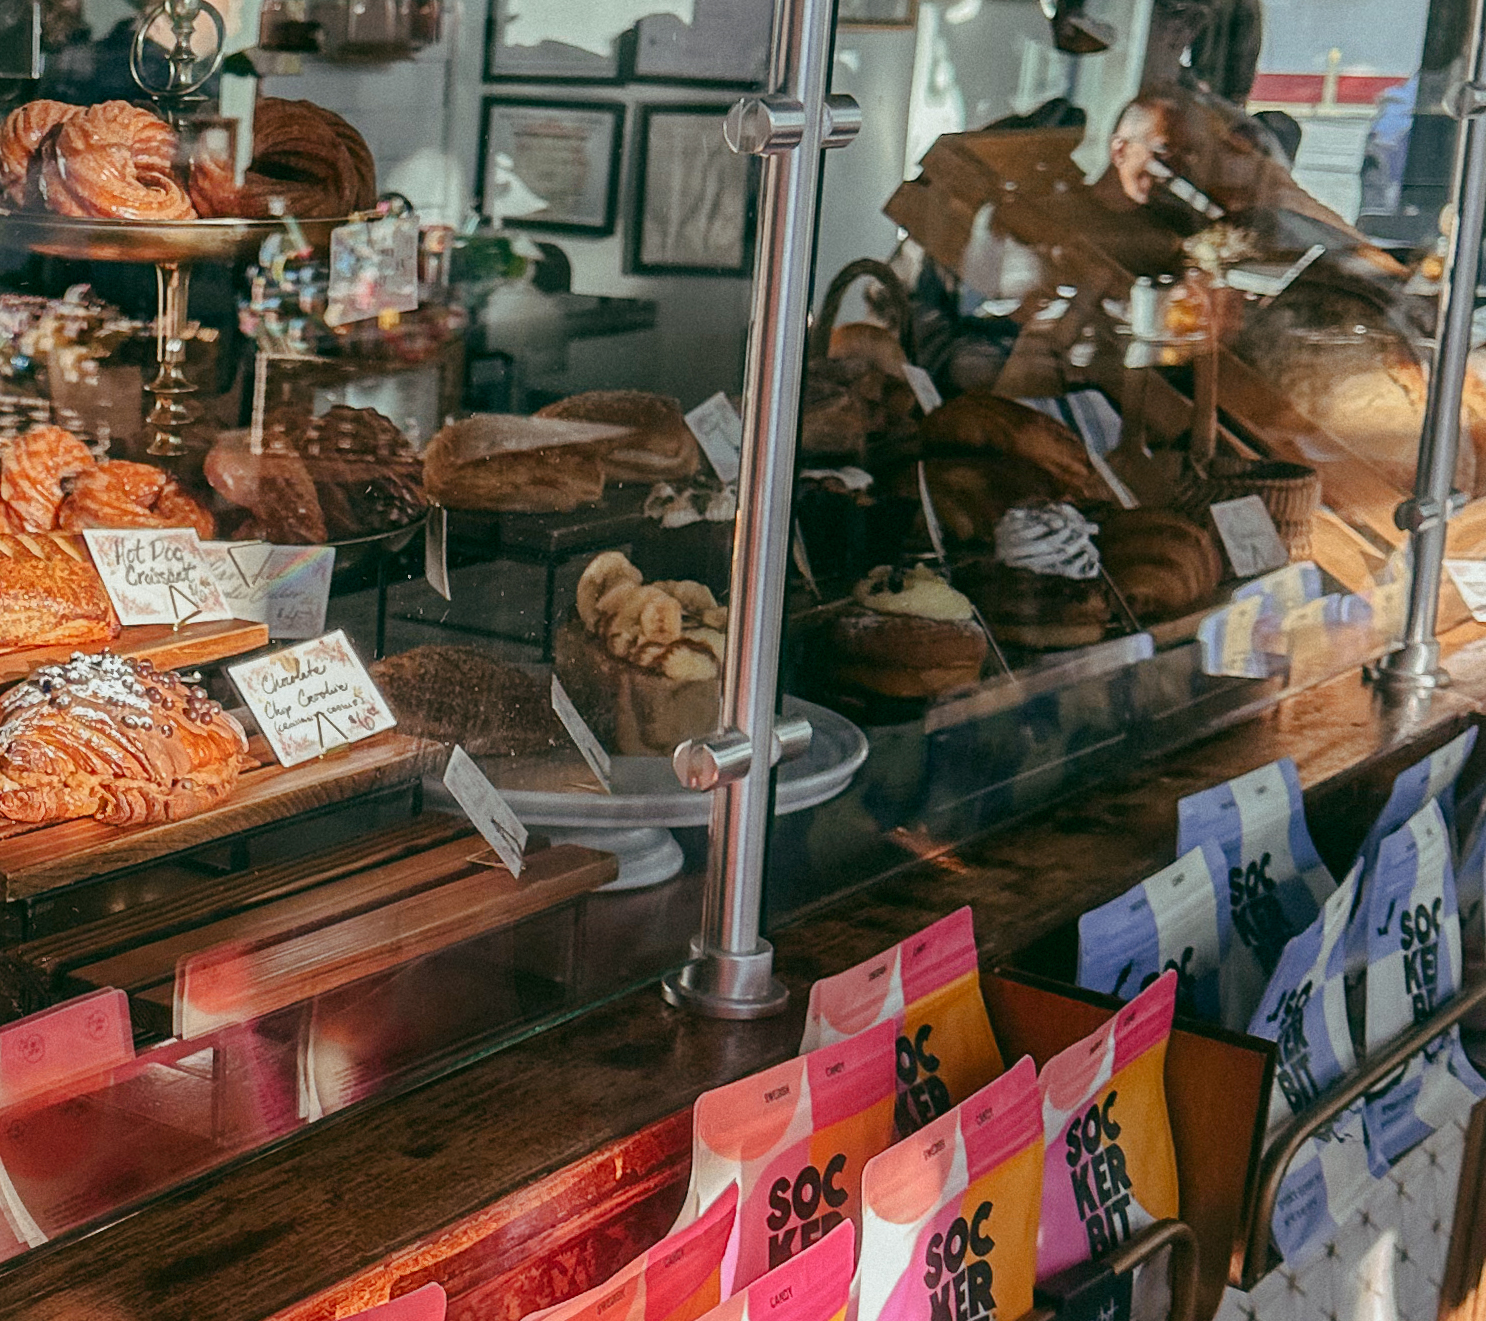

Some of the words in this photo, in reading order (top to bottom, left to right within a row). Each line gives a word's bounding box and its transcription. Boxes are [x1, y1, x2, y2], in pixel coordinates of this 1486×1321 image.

[114, 537, 145, 567] Hot
[150, 539, 185, 567] Dog
[261, 659, 327, 694] Chocolate
[895, 1024, 940, 1085] OC
[1066, 1090, 1122, 1168] SOC
[766, 1153, 848, 1232] SOC
[1070, 1143, 1133, 1222] KER
[924, 1201, 995, 1290] SOC
[1086, 1193, 1131, 1262] BIT
[770, 1285, 794, 1309] CANDY
